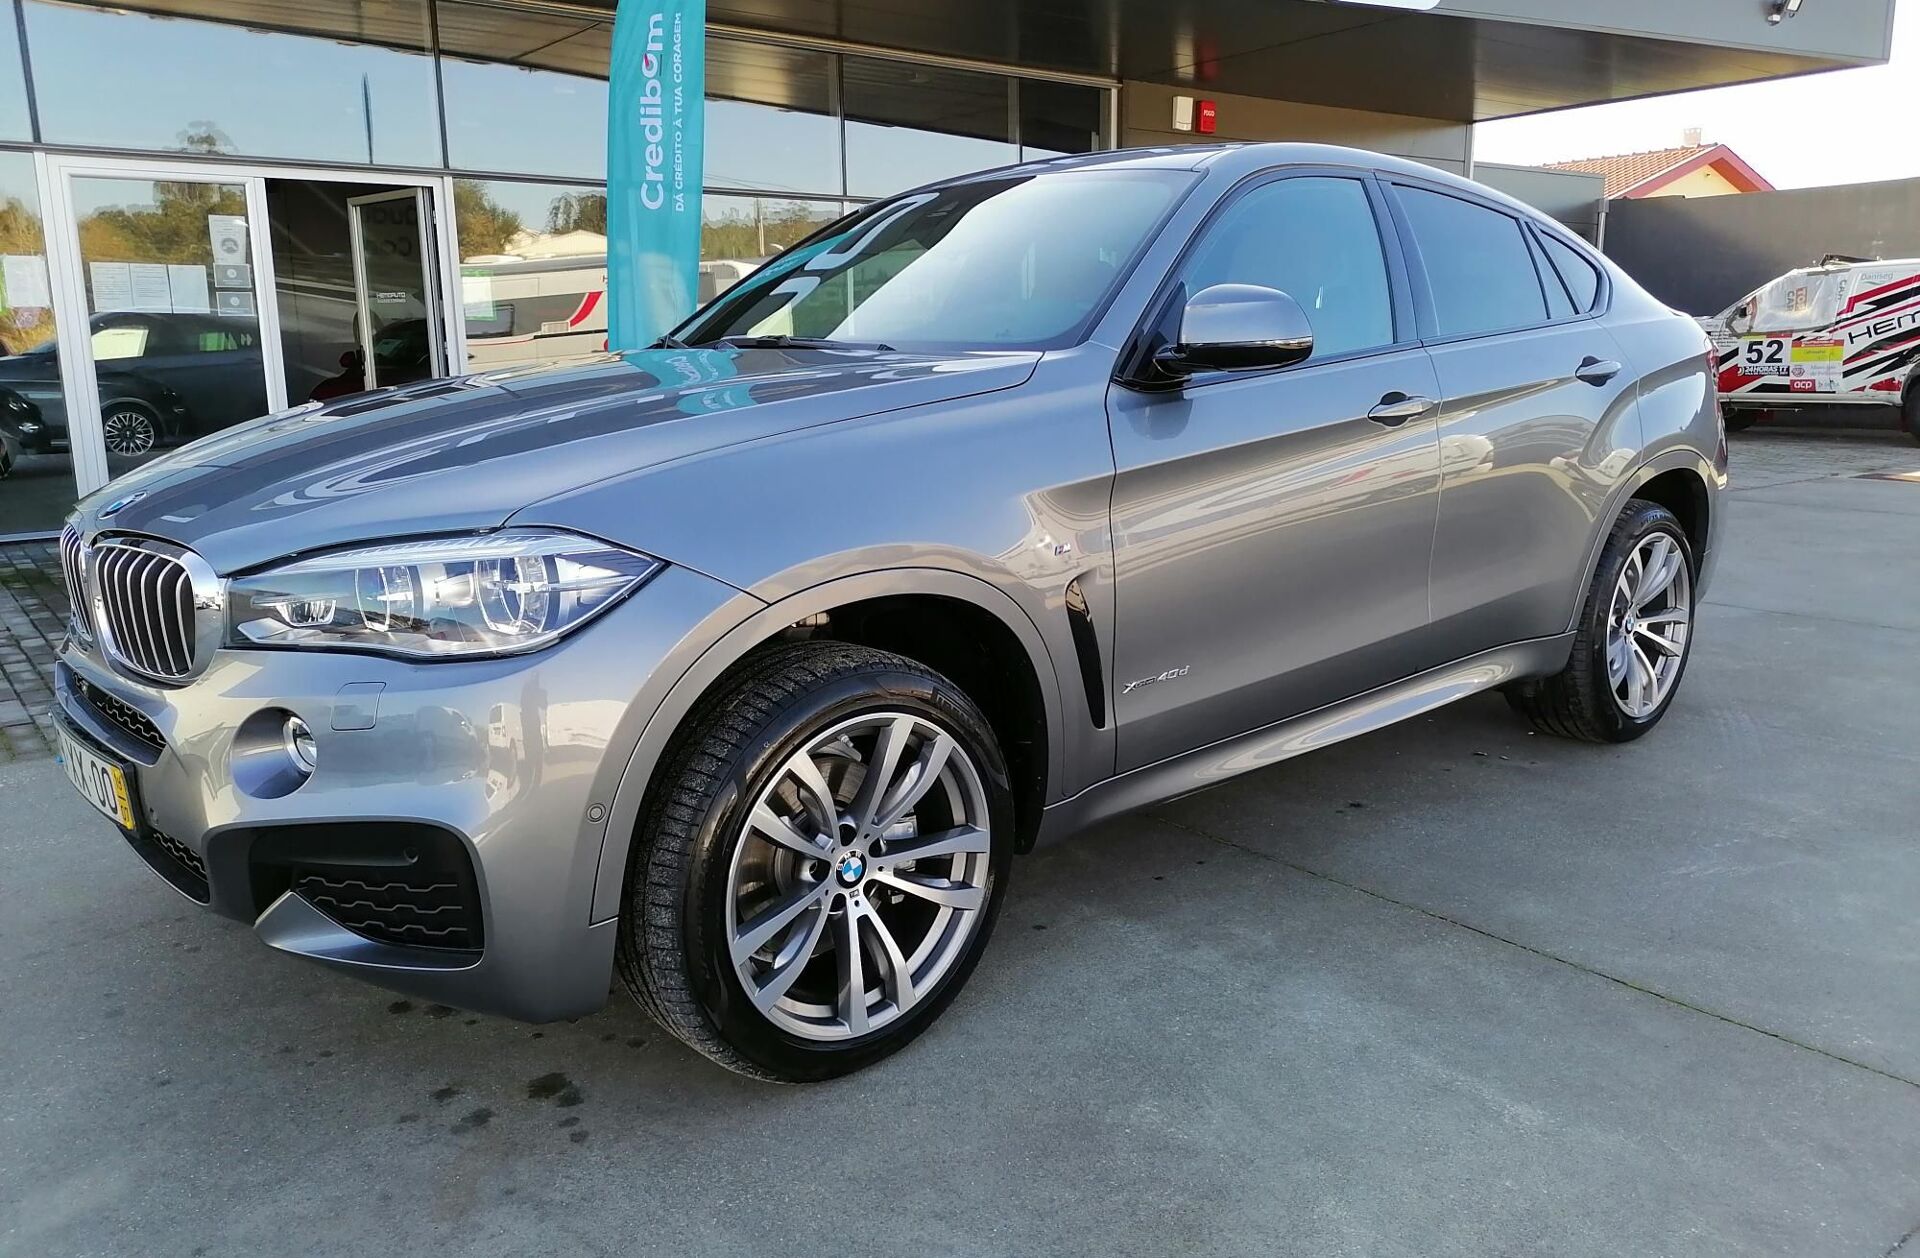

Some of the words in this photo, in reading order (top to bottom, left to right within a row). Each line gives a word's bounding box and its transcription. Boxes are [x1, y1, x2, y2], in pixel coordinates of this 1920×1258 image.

[672, 12, 683, 83] CORAGEM
[640, 13, 664, 210] Credibom
[675, 86, 683, 115] TUA
[673, 131, 684, 190] CRÉDITO
[673, 193, 685, 212] DÁ
[1745, 339, 1784, 364] 52
[1793, 380, 1813, 390] acp
